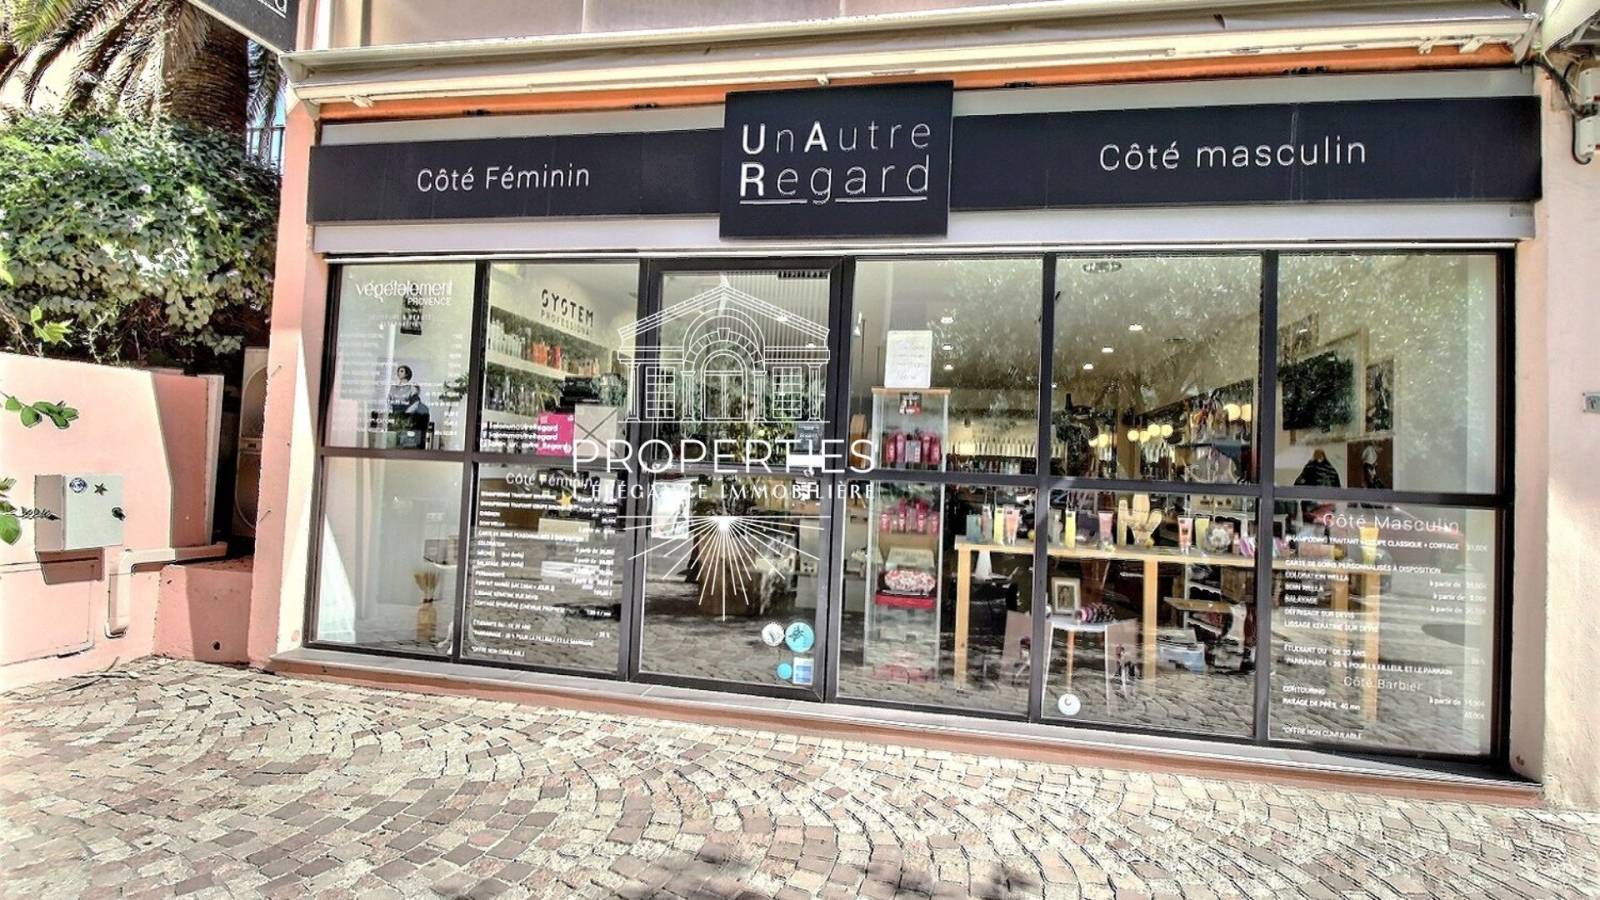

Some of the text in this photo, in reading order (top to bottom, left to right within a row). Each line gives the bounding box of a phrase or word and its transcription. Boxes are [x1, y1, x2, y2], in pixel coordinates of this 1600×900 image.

[1099, 135, 1366, 171] Côté masculin
[417, 163, 590, 192] Côté Féminin
[740, 154, 930, 204] Regard
[406, 296, 452, 307] PROVENCE
[541, 288, 594, 327] SYSTEM
[505, 472, 536, 487] Côté
[1323, 513, 1460, 535] Côté Masculin
[1387, 540, 1422, 549] CLASSIQUE
[1377, 678, 1424, 693] Barbier
